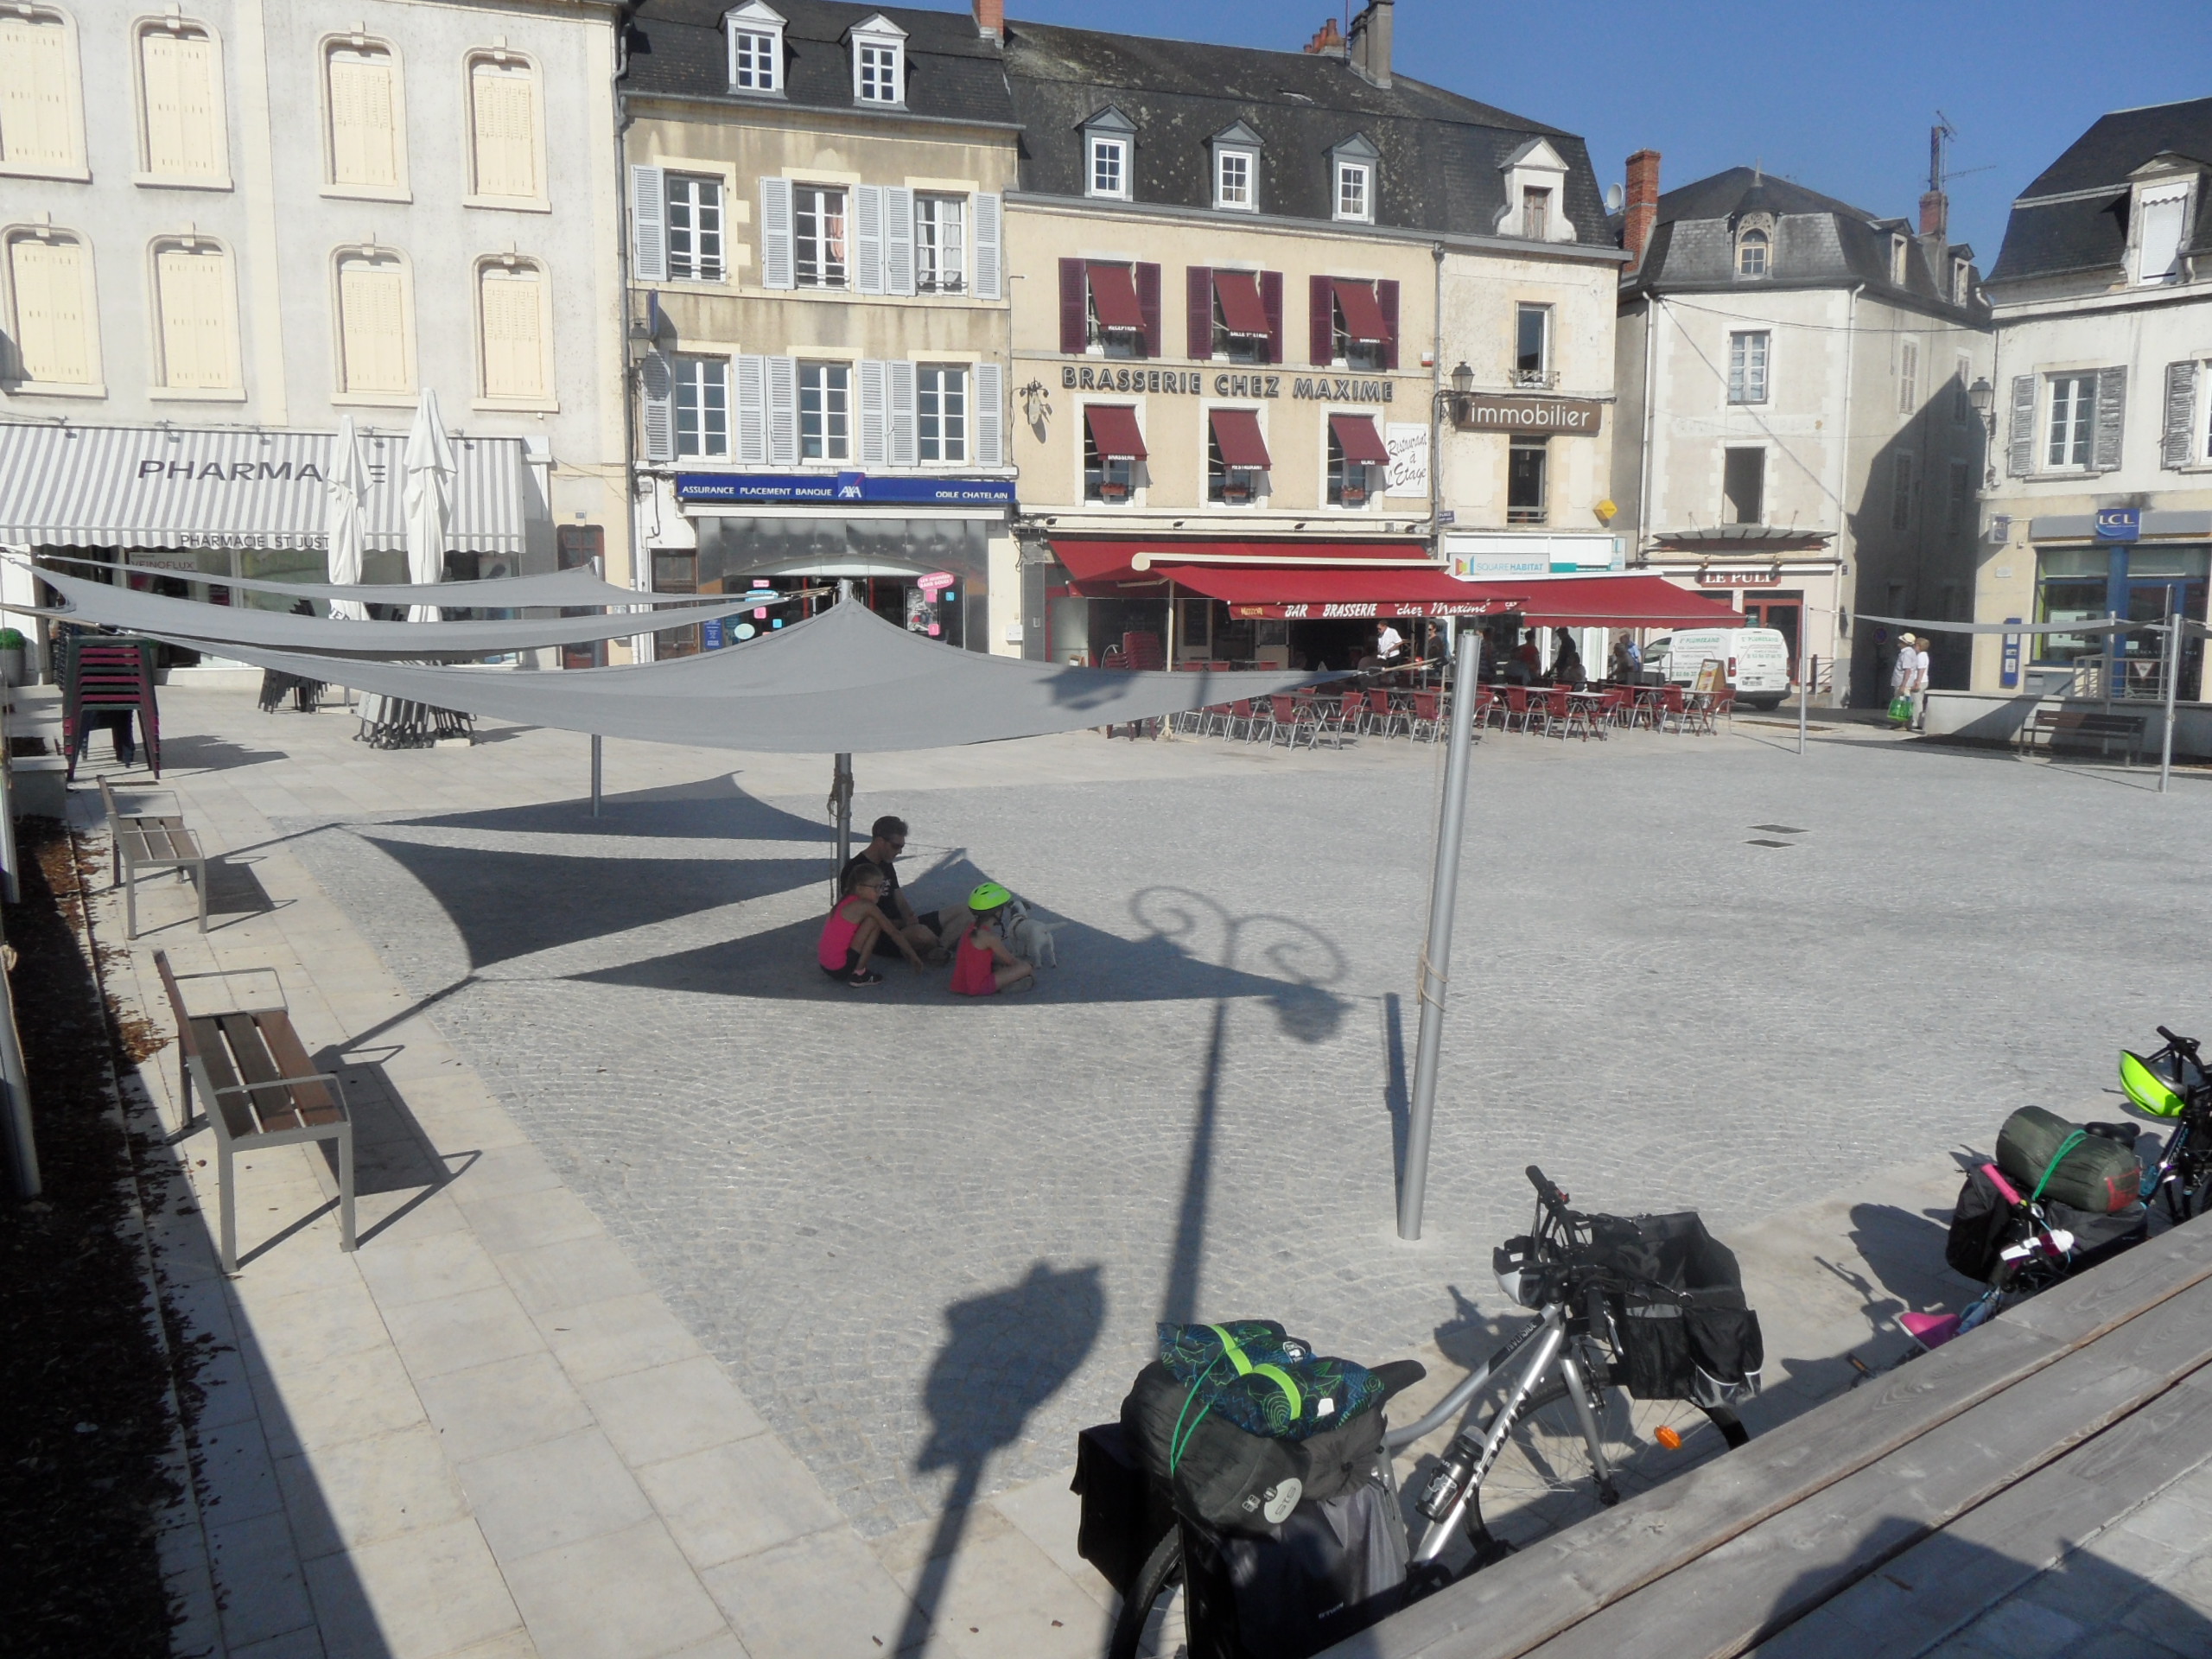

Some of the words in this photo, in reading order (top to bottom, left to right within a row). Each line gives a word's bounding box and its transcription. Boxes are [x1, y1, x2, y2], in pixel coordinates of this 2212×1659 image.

[1062, 366, 1201, 395] BRASSERIE
[1214, 373, 1281, 397] CHEZ
[1293, 378, 1393, 403] MAXIME
[1471, 402, 1591, 427] immobilier
[137, 460, 386, 484] PHARMAE
[682, 486, 734, 495] ASSURANCE
[740, 487, 791, 496] PLACEMENT
[837, 486, 861, 499] AXA
[2099, 513, 2136, 525] LCL
[181, 535, 264, 547] PHARMACIE
[276, 537, 292, 548] ST
[297, 537, 329, 549] JUST
[1510, 563, 1544, 571] HABITAT
[1705, 573, 1726, 583] LE
[1285, 603, 1309, 617] BAR
[1323, 603, 1378, 617] BRASSERIE
